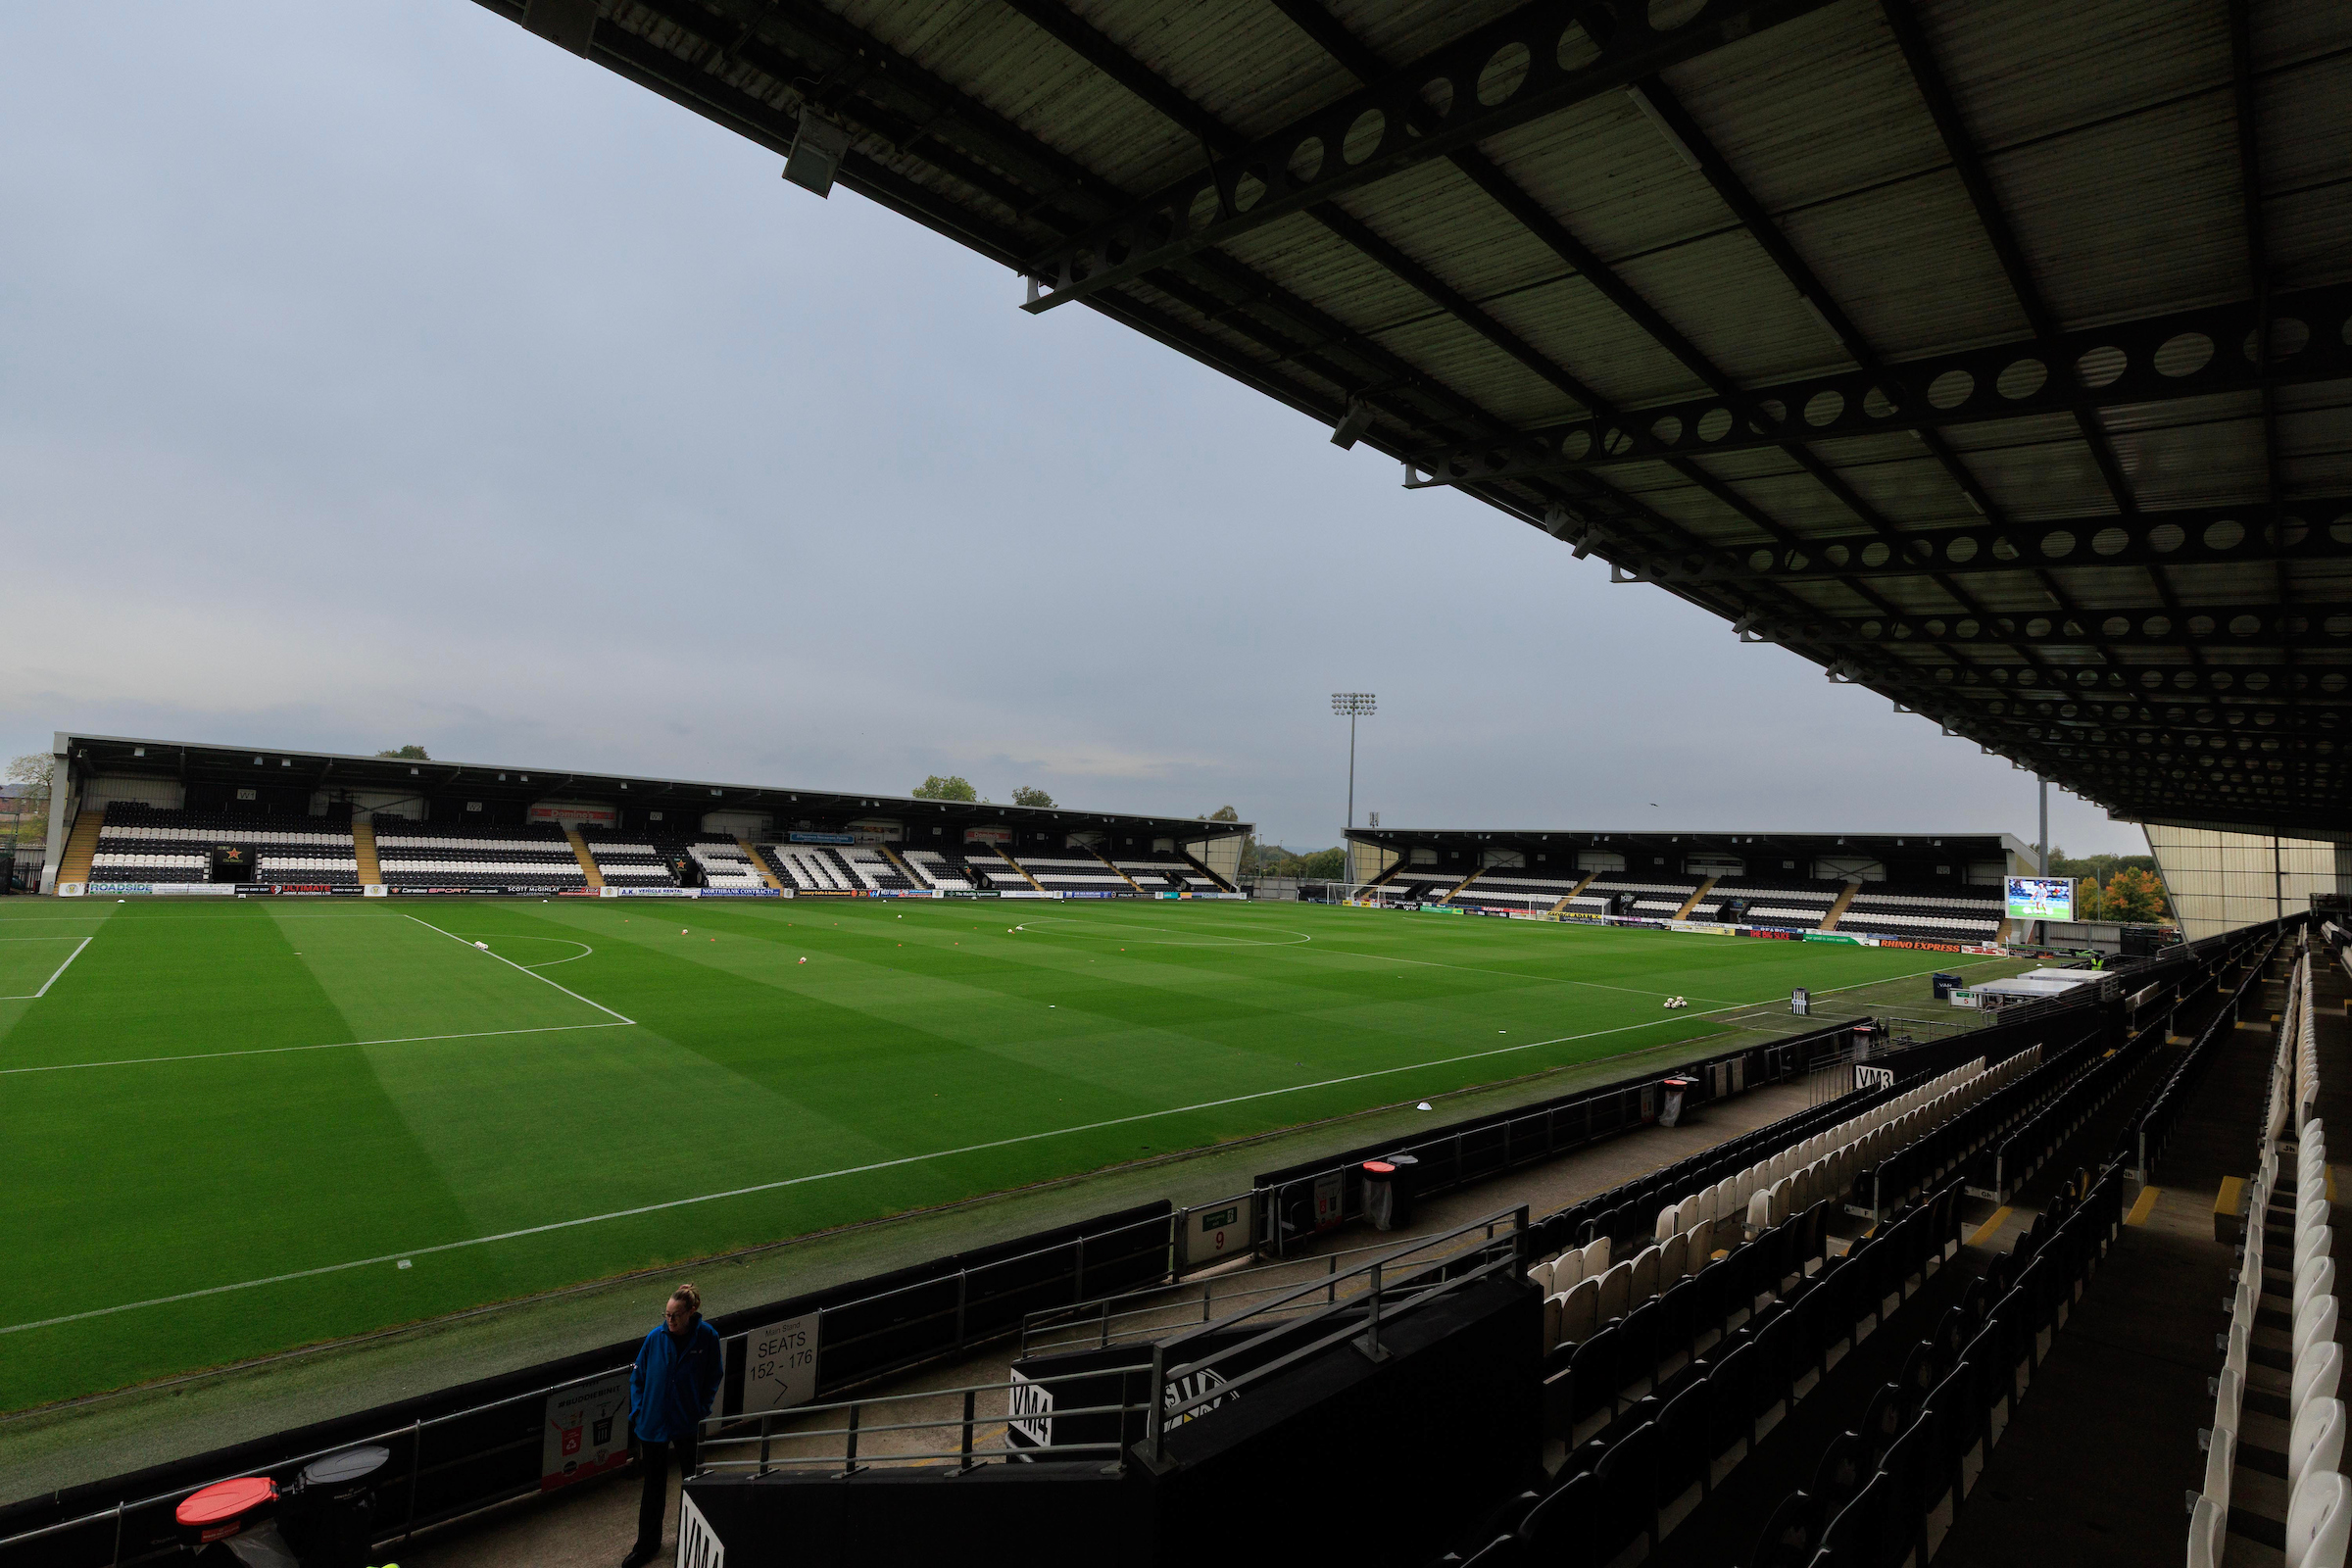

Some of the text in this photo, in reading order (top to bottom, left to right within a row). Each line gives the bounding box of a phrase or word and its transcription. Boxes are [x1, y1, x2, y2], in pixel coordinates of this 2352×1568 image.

[239, 791, 255, 800] W1
[467, 803, 481, 811] W2
[551, 809, 594, 819] Domino's
[1881, 939, 1913, 950] RHINO
[1914, 942, 1960, 953] EXPRESS
[1858, 1067, 1891, 1092] VM3
[1215, 1231, 1224, 1250] 9
[765, 1321, 801, 1339] Main Stand
[758, 1331, 806, 1358] SEATS
[750, 1360, 774, 1381] 152
[789, 1348, 812, 1369] 176
[558, 1385, 621, 1408] #BUDDIEBINIT
[1012, 1376, 1048, 1443] VM4
